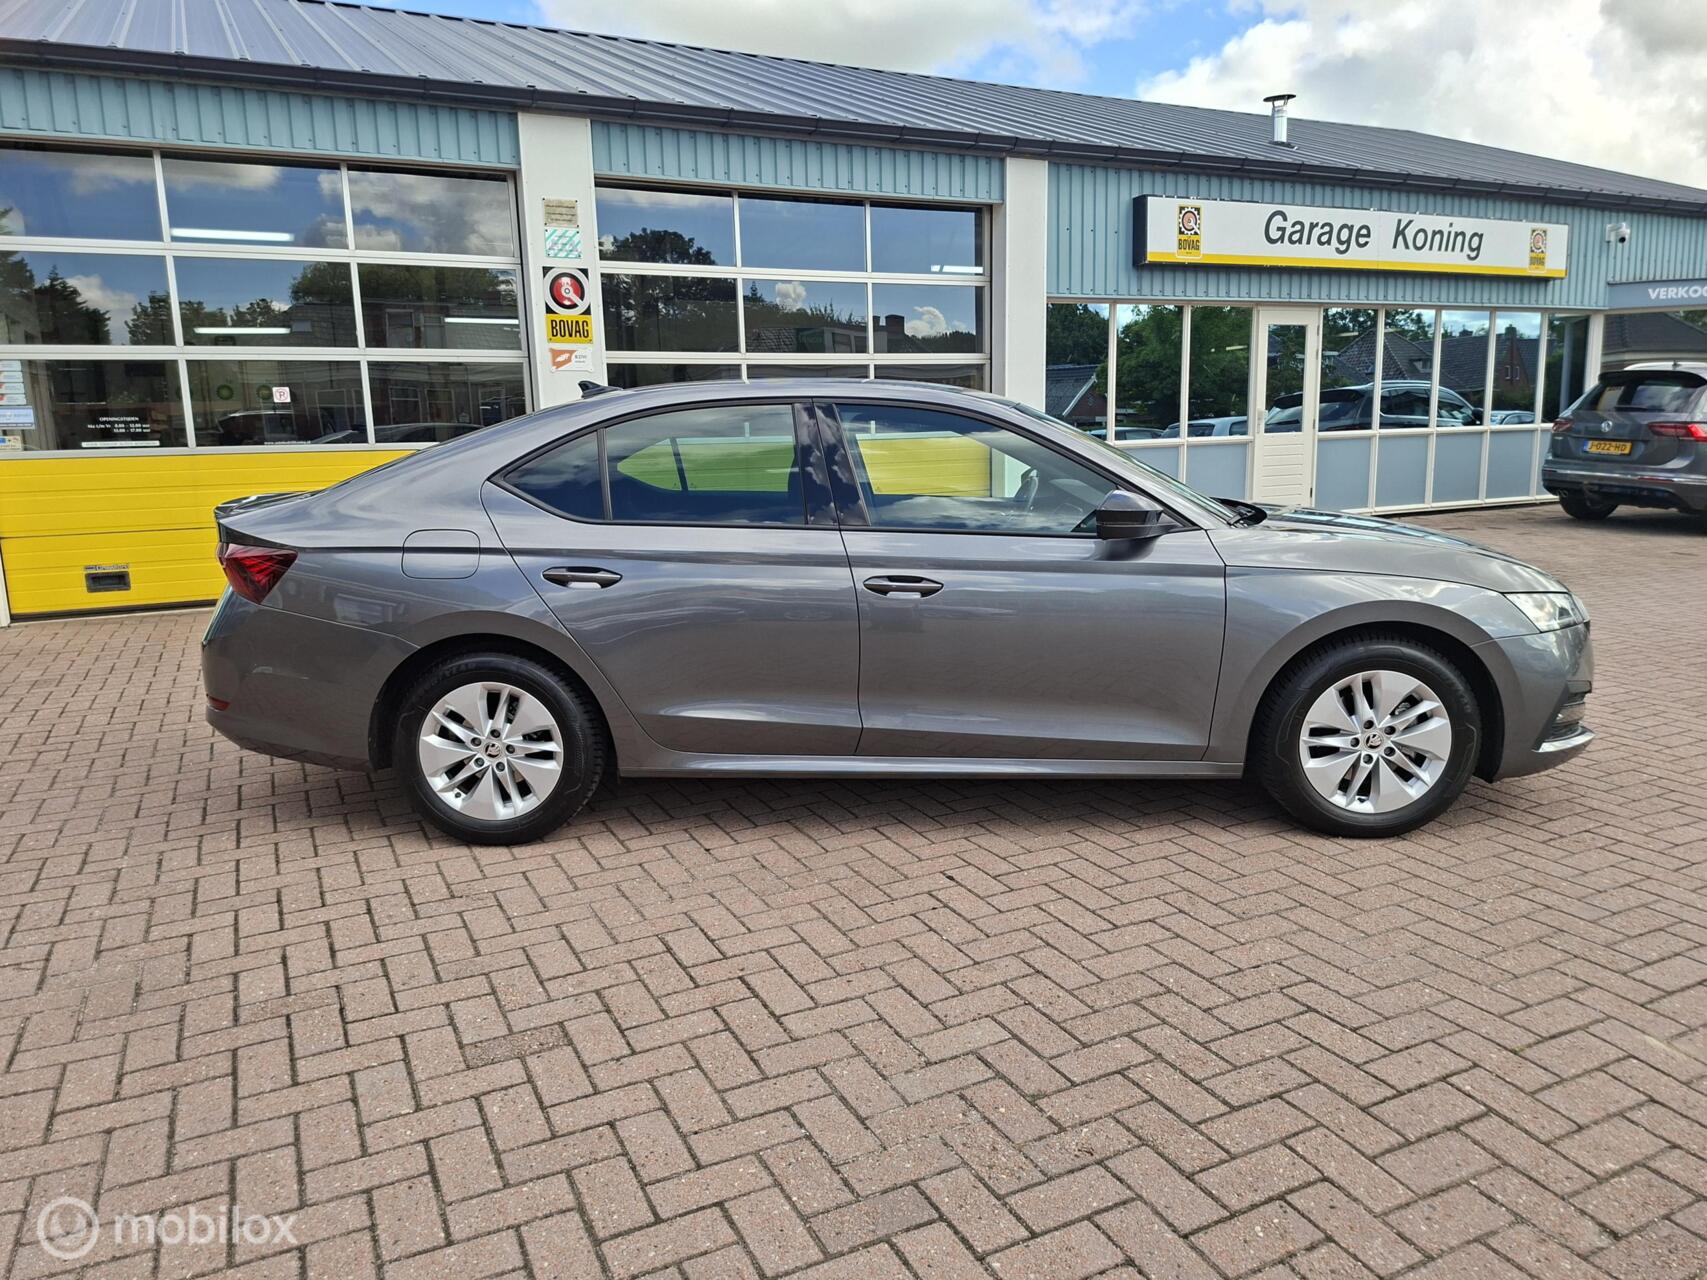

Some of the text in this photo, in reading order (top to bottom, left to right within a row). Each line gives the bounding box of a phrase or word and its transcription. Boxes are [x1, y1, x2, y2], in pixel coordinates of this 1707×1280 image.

[1178, 239, 1200, 251] BOVAG
[1264, 210, 1484, 261] Garage Koning
[550, 319, 590, 338] BOVAG
